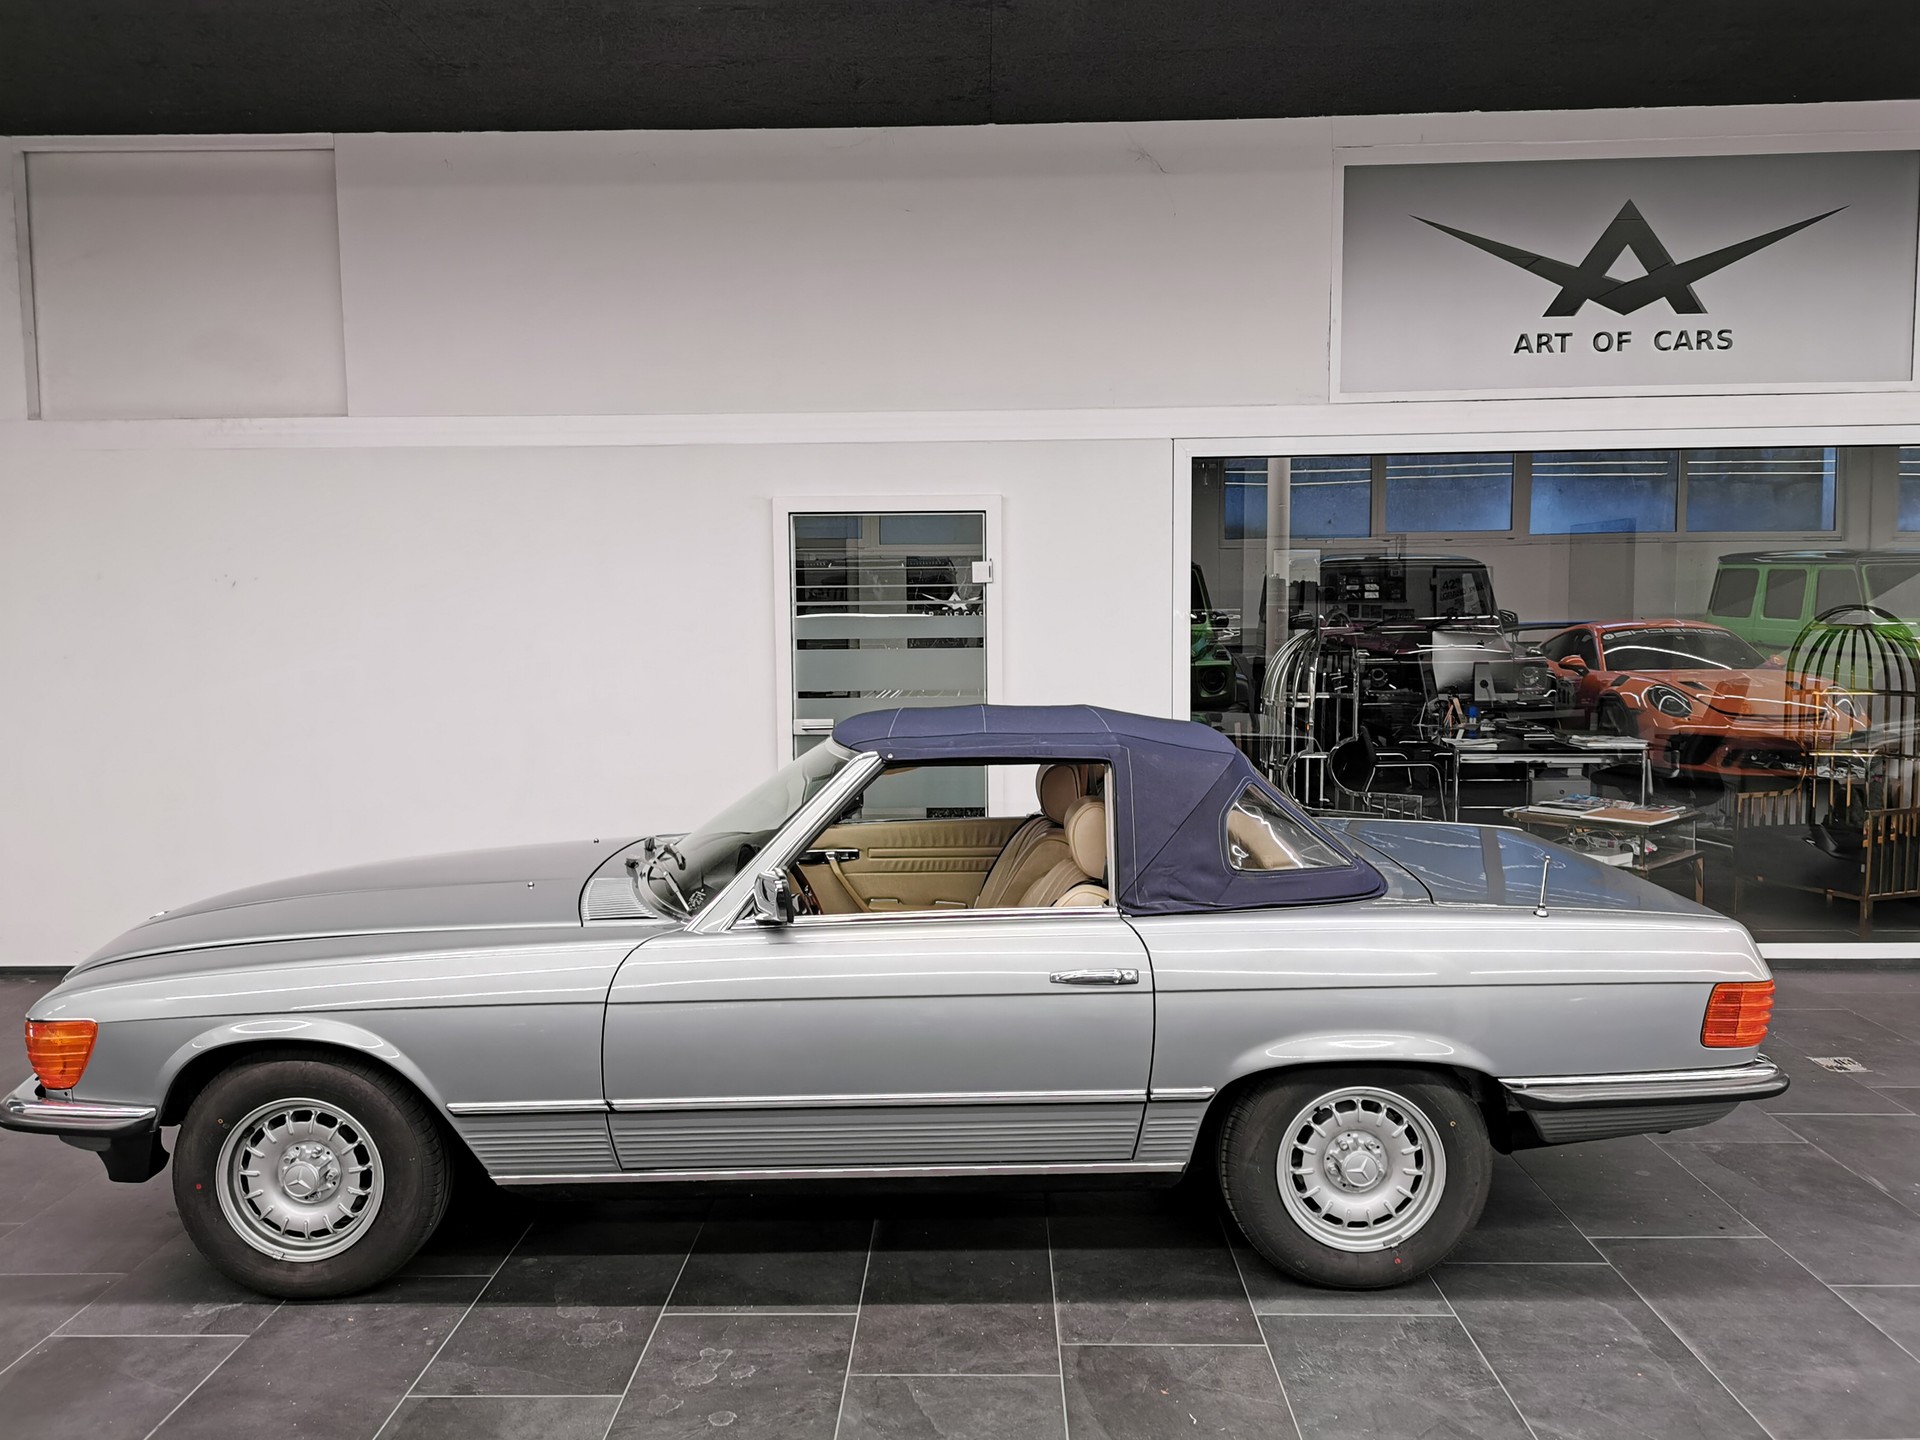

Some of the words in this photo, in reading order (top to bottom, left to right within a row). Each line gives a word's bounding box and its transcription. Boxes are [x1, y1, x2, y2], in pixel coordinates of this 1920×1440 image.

[1513, 333, 1573, 354] ART
[1592, 331, 1632, 352] OF
[1653, 329, 1734, 352] CARS
